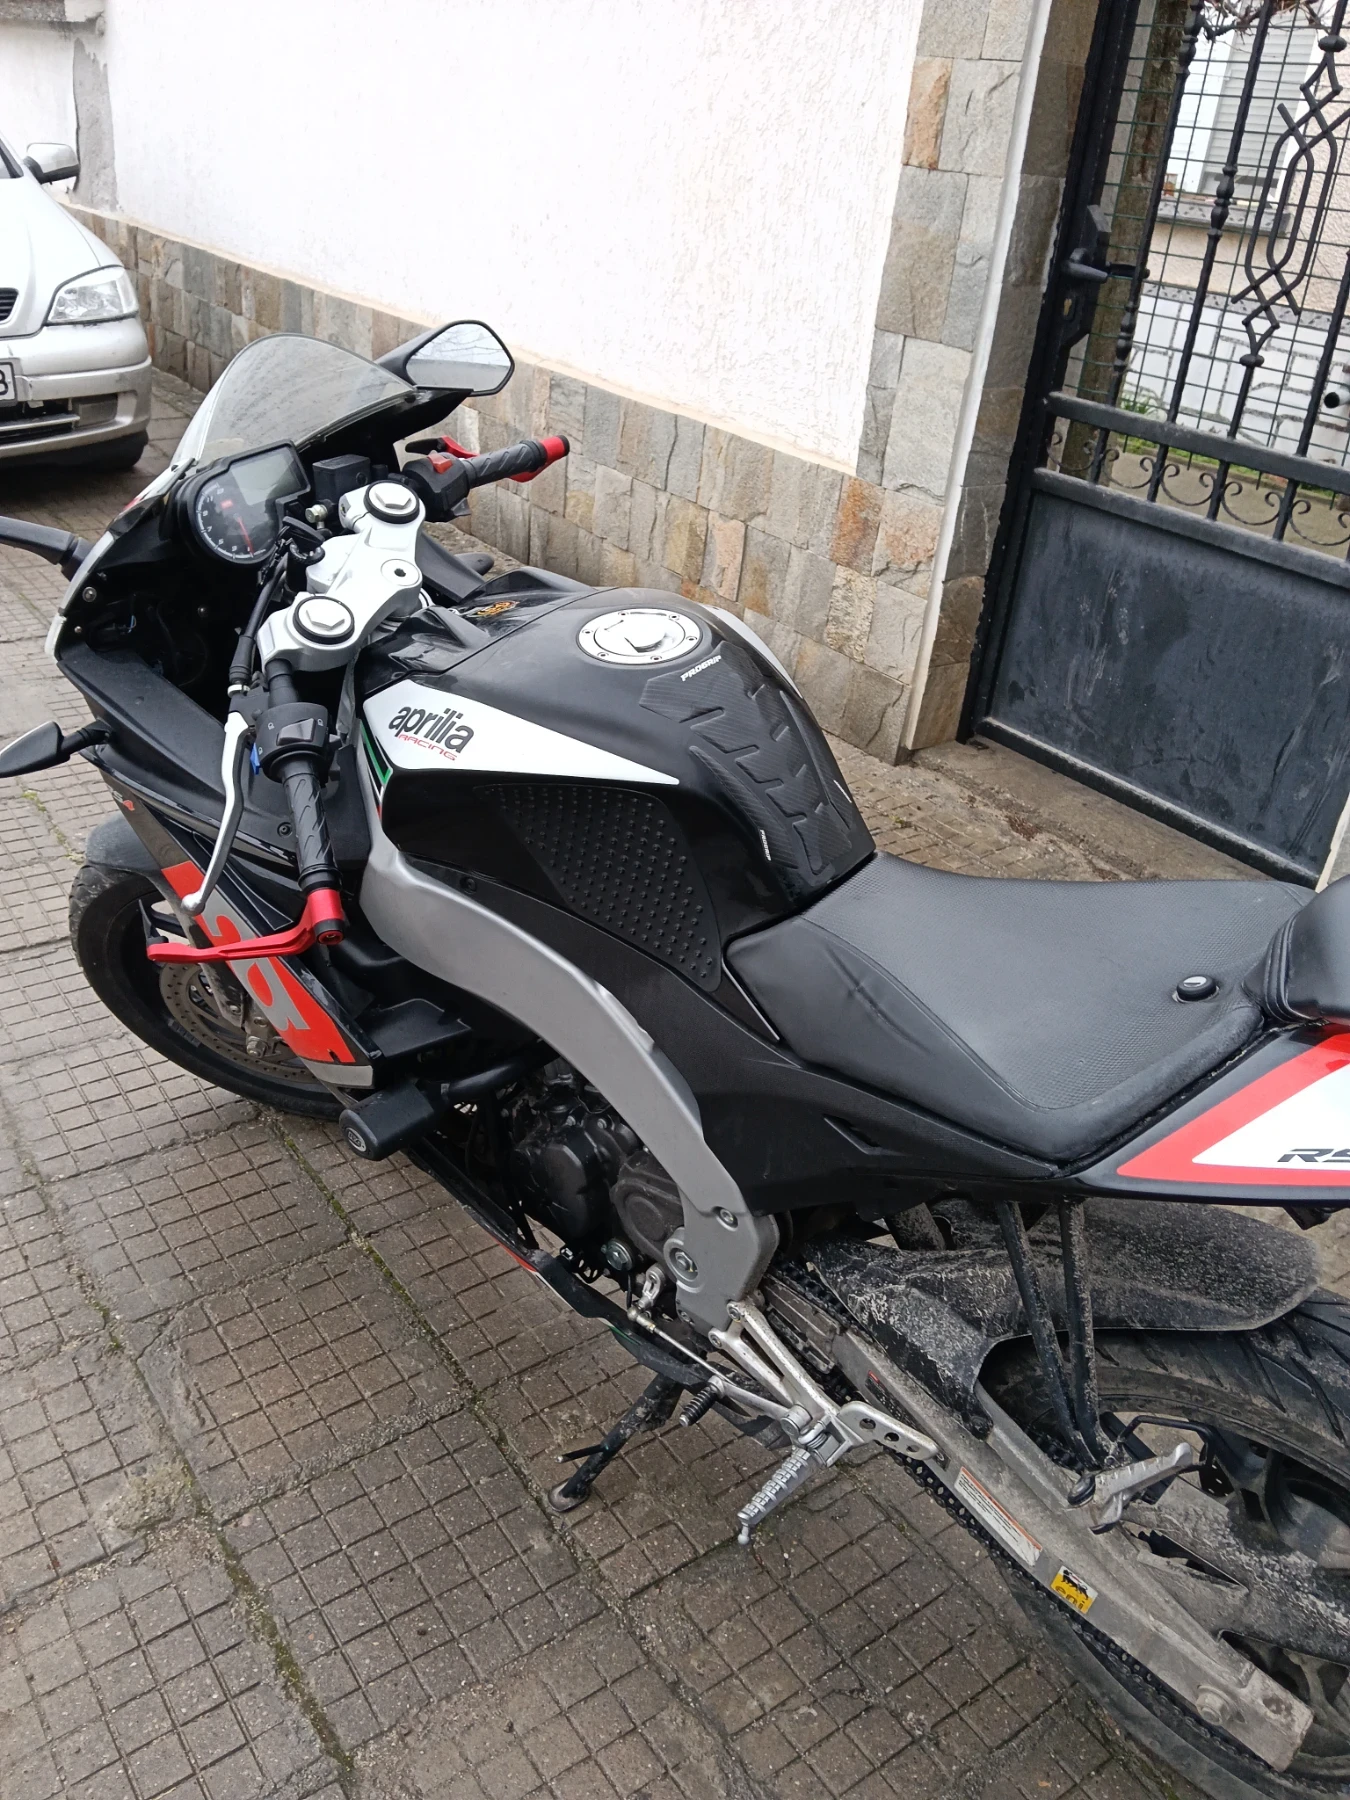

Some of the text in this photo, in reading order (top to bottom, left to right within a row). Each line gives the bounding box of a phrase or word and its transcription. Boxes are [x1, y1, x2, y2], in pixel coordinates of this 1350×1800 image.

[680, 654, 722, 682] PROGRIP
[388, 706, 474, 753] aprilia
[397, 733, 457, 761] RACING
[1055, 1585, 1086, 1610] eni
